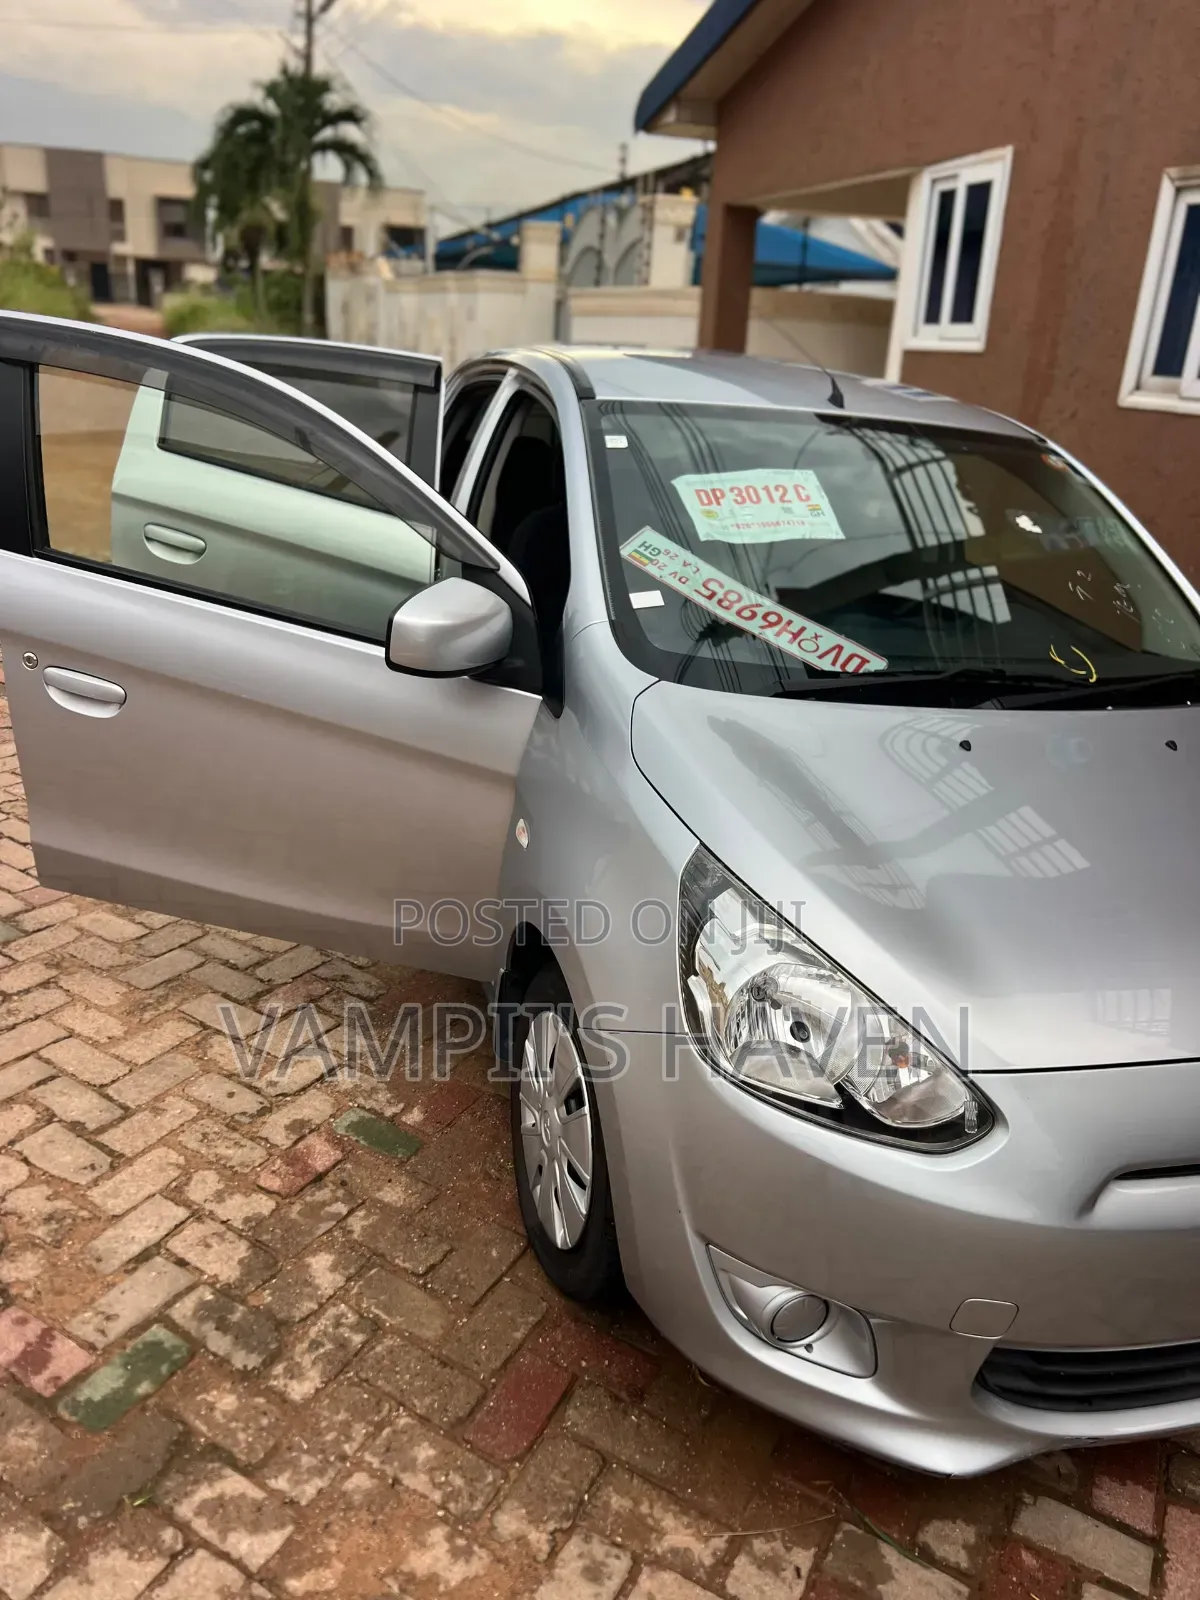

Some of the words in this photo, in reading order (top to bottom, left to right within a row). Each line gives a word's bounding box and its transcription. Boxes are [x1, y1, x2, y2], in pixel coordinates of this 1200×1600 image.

[694, 487, 726, 507] DP
[729, 484, 793, 506] 3012
[796, 483, 812, 503] C
[809, 510, 826, 518] GH
[638, 541, 662, 557] GH
[663, 549, 679, 560] 26
[651, 558, 668, 571] 20
[682, 559, 702, 574] LA
[668, 571, 690, 585] DV
[817, 643, 872, 673] DV
